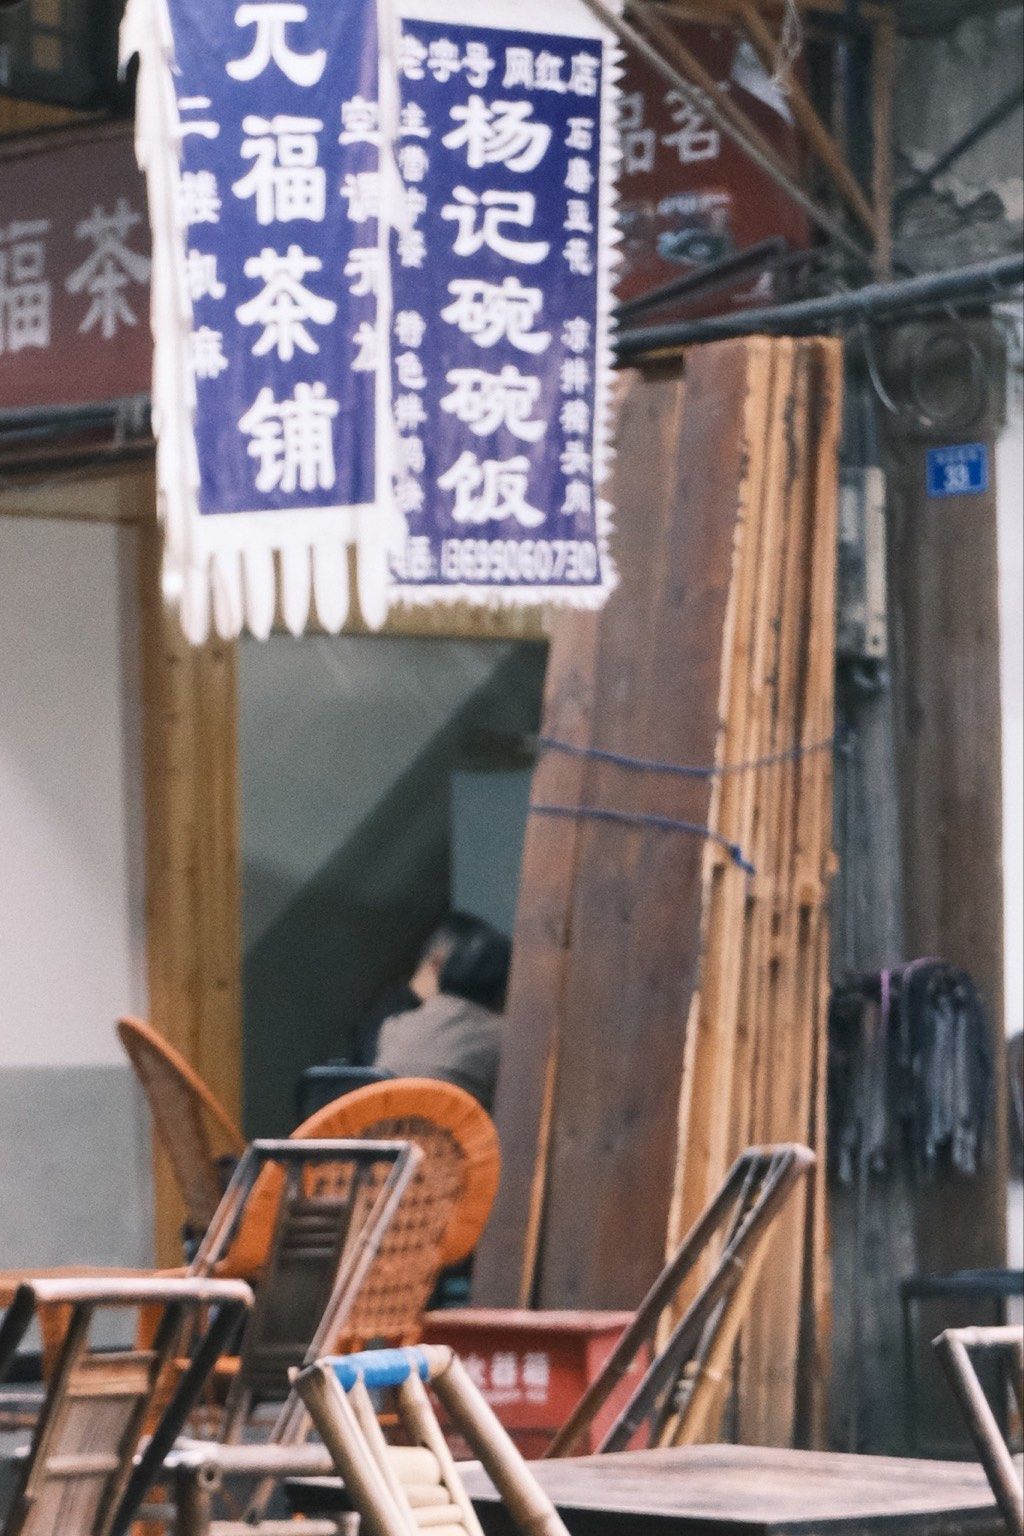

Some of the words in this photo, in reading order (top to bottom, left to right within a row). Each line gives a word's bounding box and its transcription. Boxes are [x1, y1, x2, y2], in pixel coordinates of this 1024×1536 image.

[226, 4, 339, 494] 元福茶铺
[438, 95, 552, 528] 杨记碗碗饭
